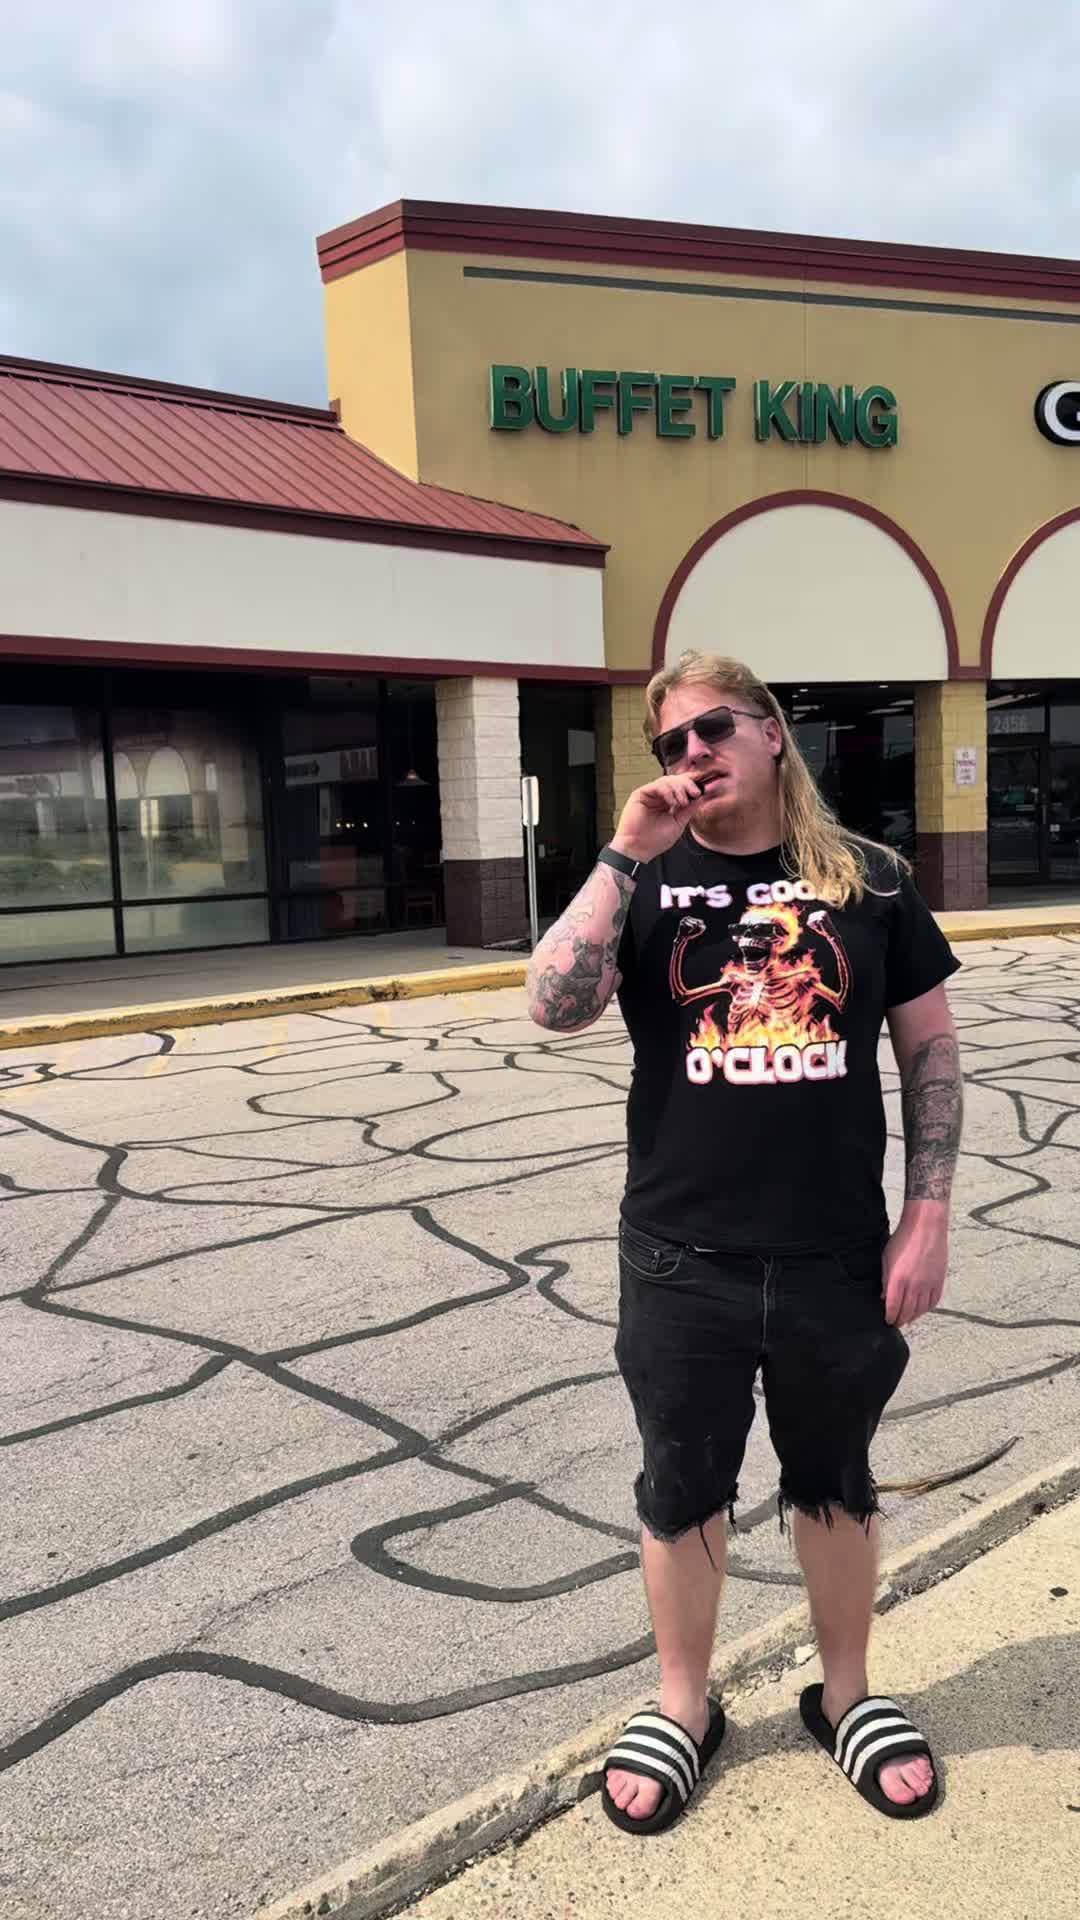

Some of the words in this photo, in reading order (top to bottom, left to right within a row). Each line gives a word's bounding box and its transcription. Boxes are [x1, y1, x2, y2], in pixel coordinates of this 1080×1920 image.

[490, 364, 736, 440] BUFFET
[754, 379, 898, 449] KING
[660, 884, 733, 909] IT'S
[746, 879, 822, 905] GOO
[686, 1040, 848, 1085] O'CLOCK
